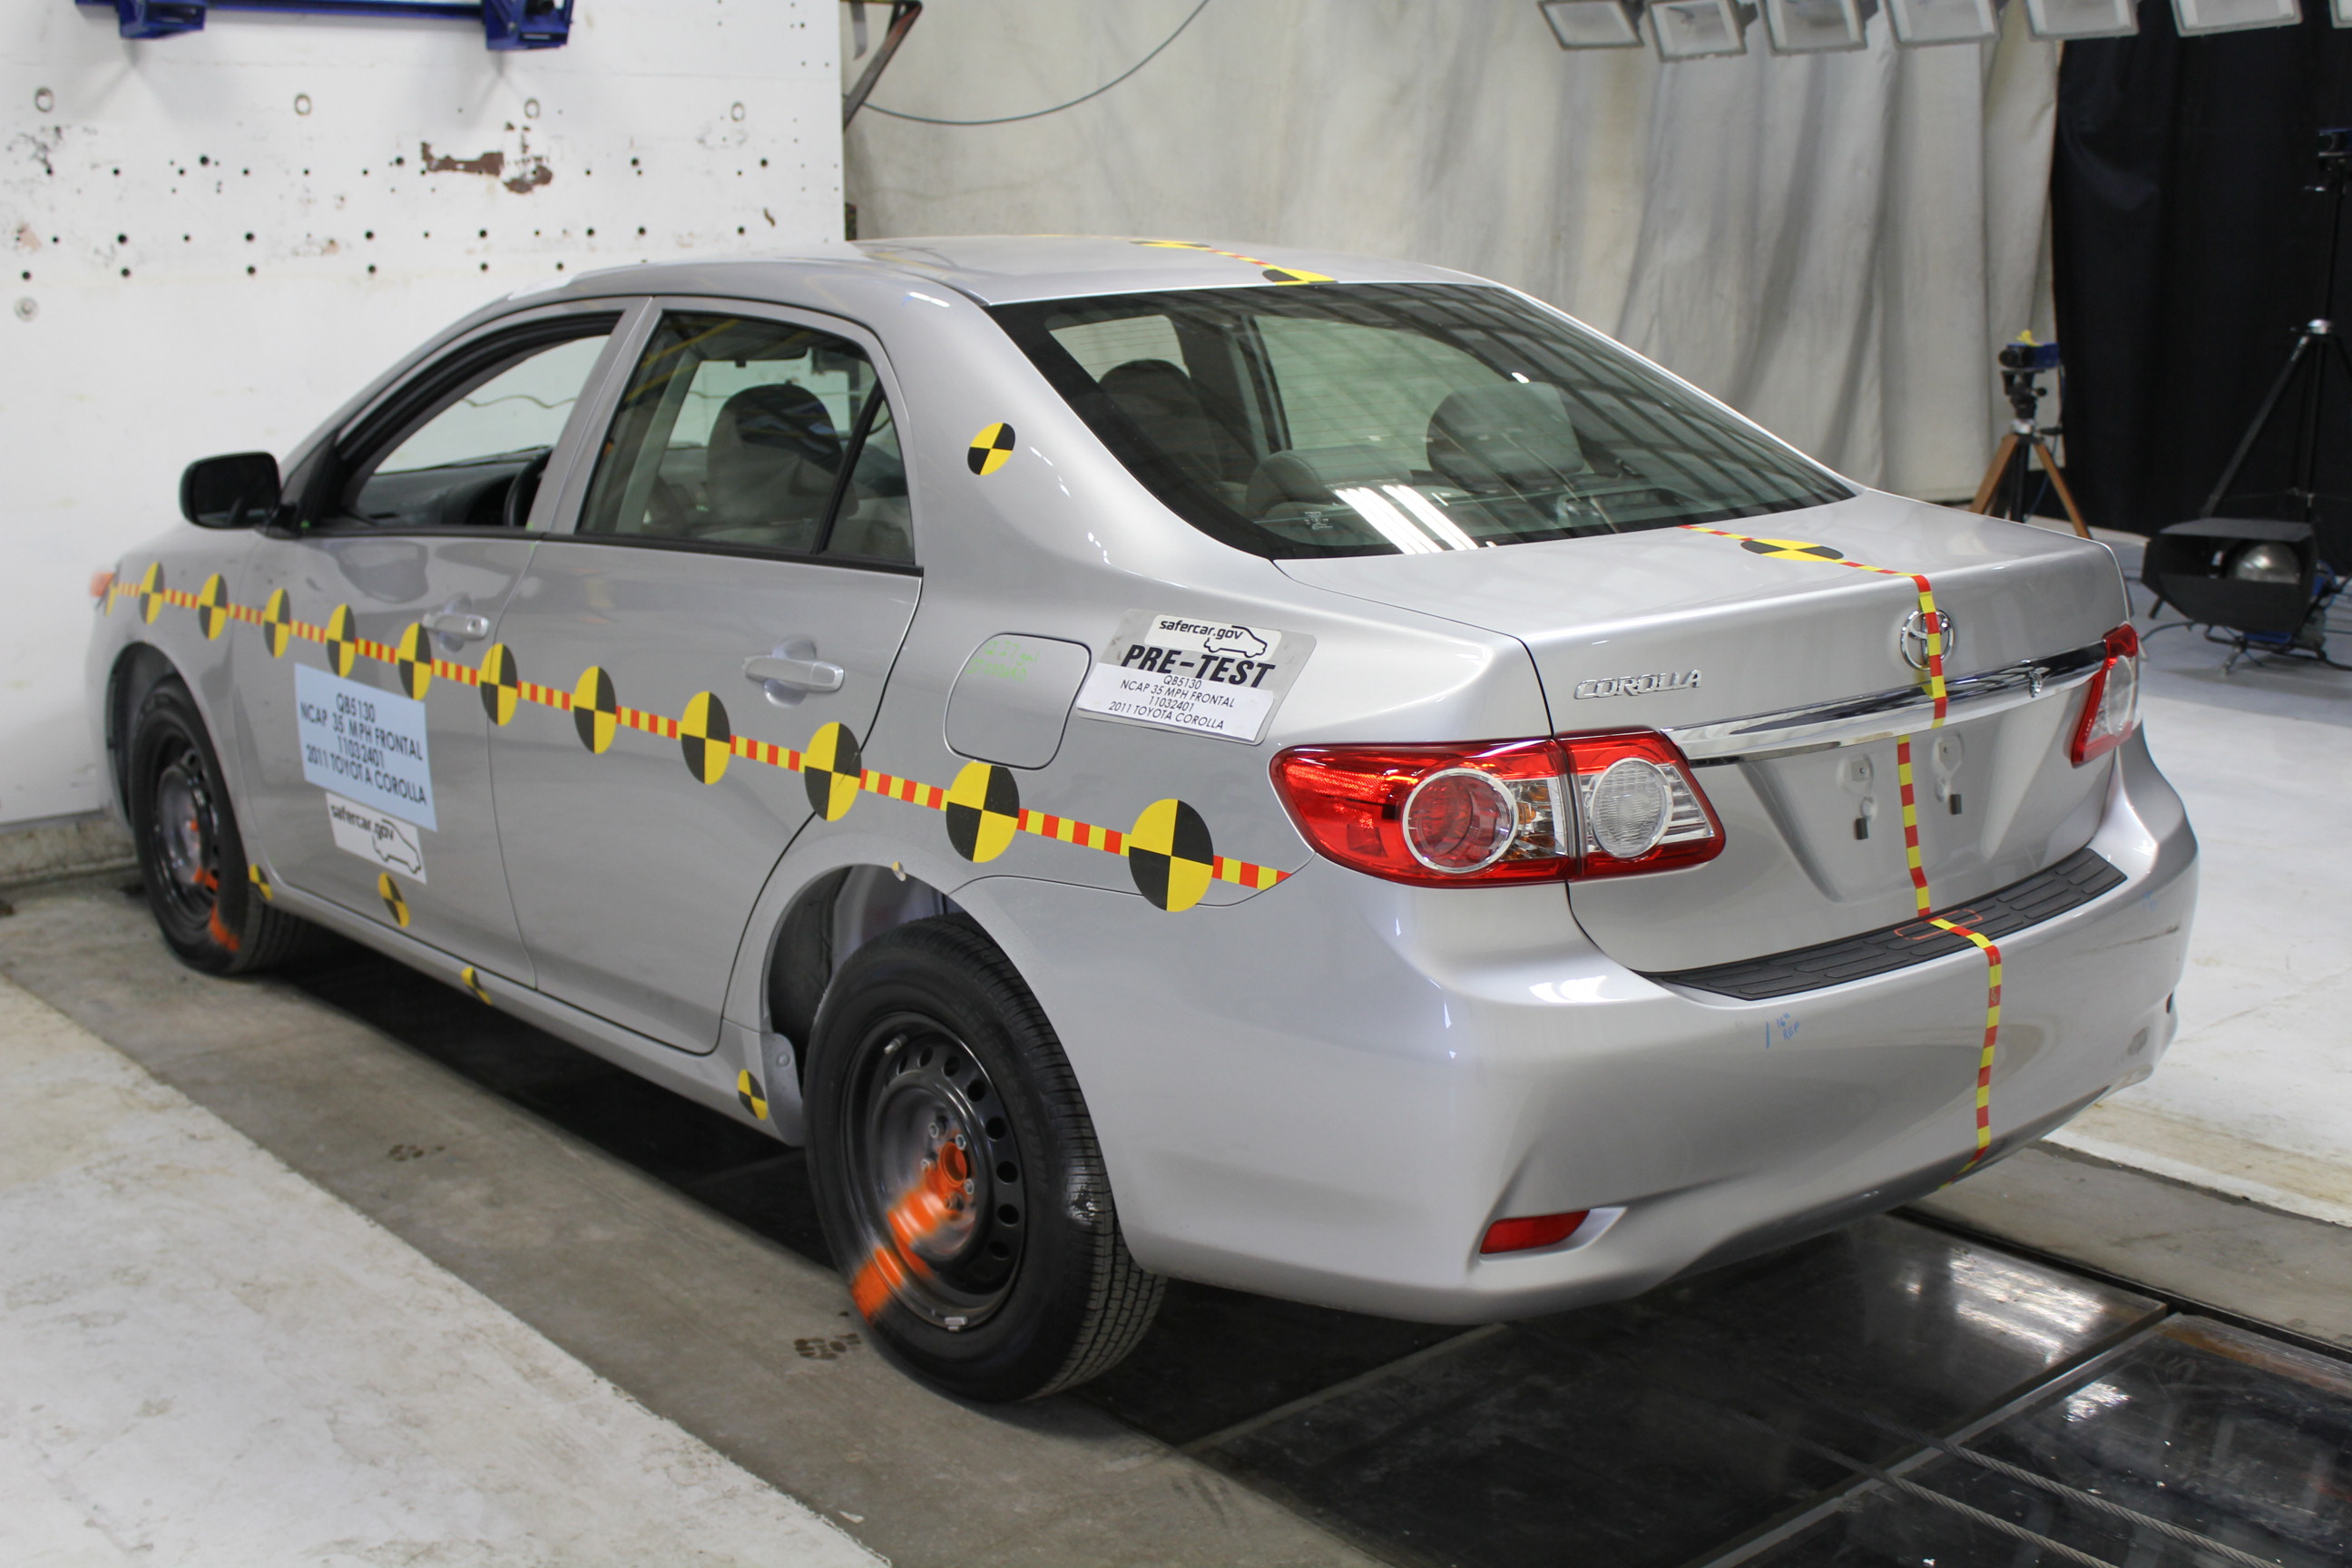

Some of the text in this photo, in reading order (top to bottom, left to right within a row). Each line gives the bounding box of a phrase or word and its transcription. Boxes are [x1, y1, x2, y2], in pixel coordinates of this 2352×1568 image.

[1160, 620, 1244, 640] safercar.gov
[1121, 644, 1277, 688] PRE-TEST
[1120, 680, 1236, 708] NCAP 35 MPH FRONTAL
[1163, 674, 1202, 690] QB5130
[1573, 668, 1702, 700] COROLLA
[337, 693, 375, 722] QB5130
[1108, 701, 1224, 730] 2011 TOYOTA COROLLA
[1148, 696, 1194, 711] 11032401
[300, 701, 423, 761] NCAP 35 MPH FRONTAL
[338, 736, 385, 769] 11032401
[306, 745, 427, 806] 2011 TOYOTA COROLLA
[330, 806, 394, 840] safercar.gov
